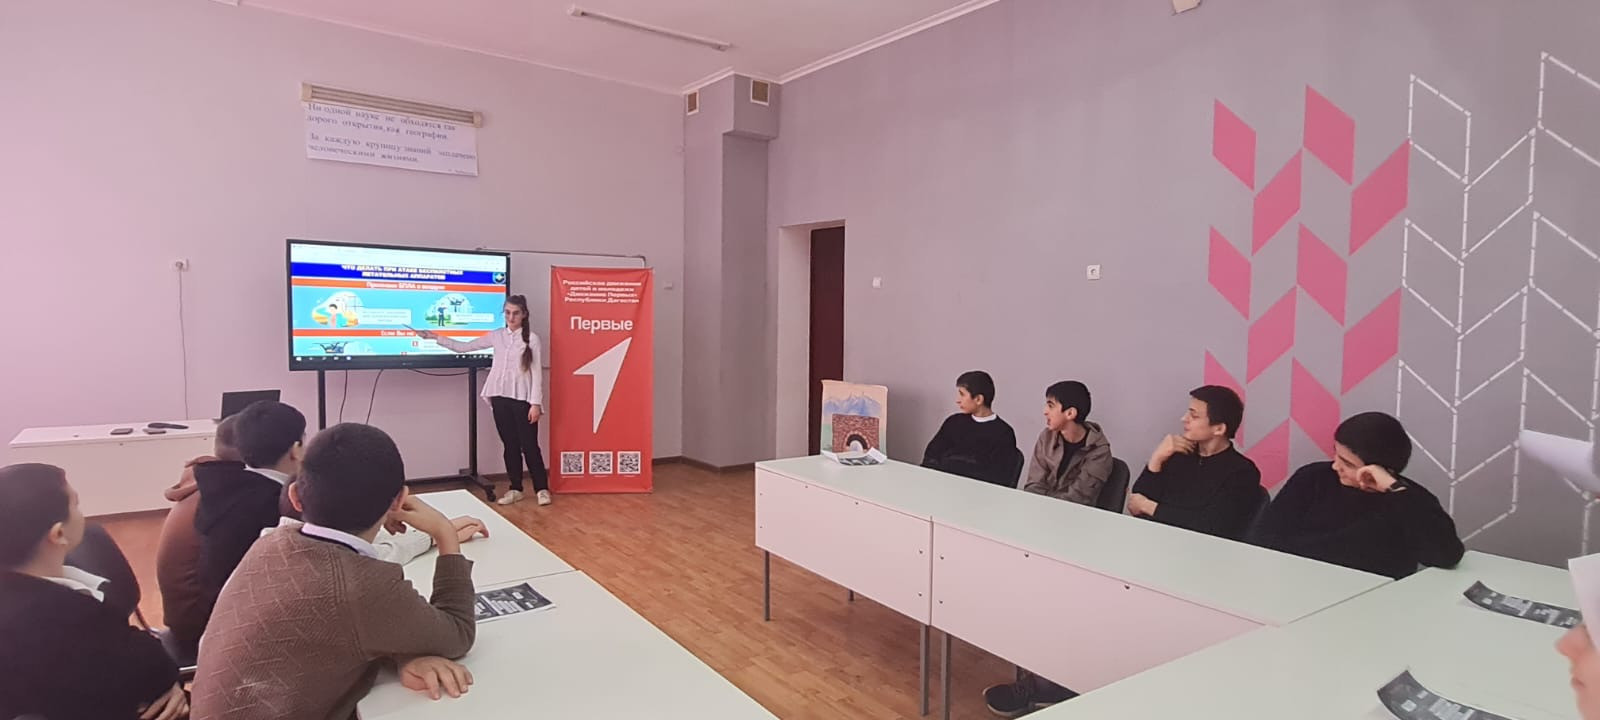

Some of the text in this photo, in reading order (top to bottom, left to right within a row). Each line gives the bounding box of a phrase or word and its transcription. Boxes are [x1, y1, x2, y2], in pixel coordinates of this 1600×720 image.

[308, 103, 322, 111] Ни
[324, 106, 351, 115] одной
[355, 110, 380, 120] науке
[324, 136, 360, 146] каждую
[570, 316, 634, 334] Первые
